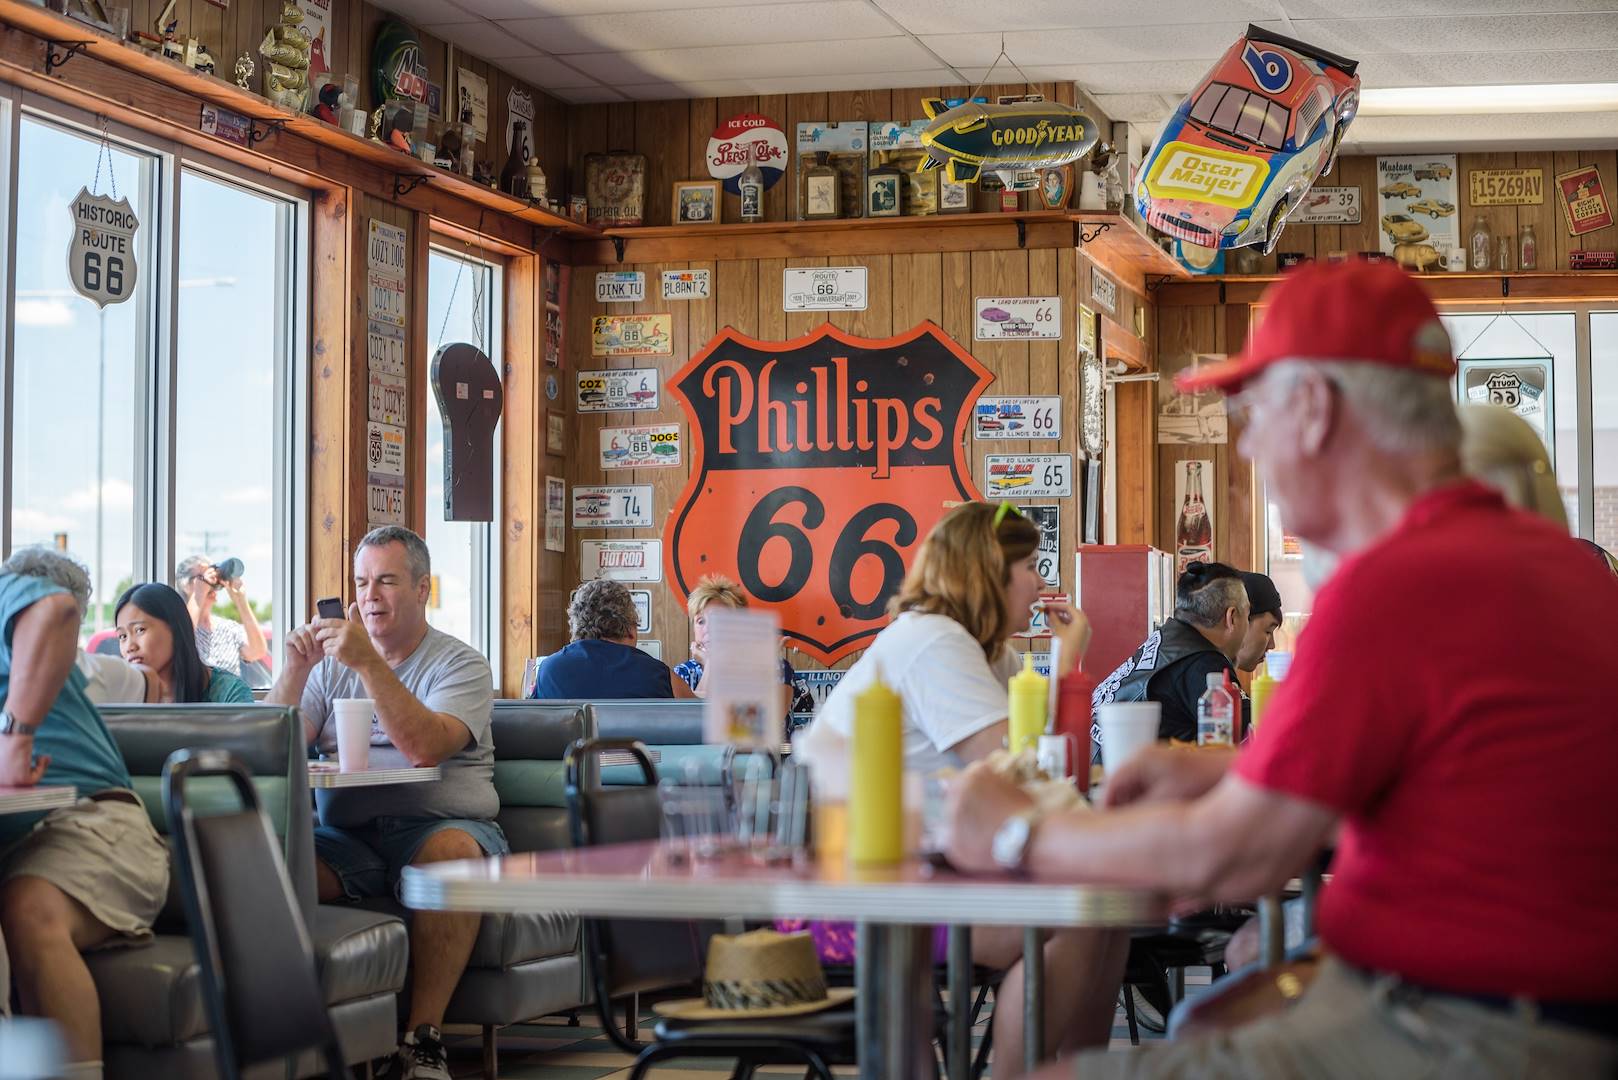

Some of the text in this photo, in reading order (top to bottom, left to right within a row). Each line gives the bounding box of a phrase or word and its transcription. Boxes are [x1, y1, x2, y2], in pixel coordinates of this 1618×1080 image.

[743, 119, 766, 127] COLD
[1182, 156, 1243, 178] Oscar
[1380, 160, 1413, 172] Mustang
[1169, 167, 1242, 193] Mayer
[1339, 194, 1354, 206] 39
[1577, 198, 1595, 208] EIGHT
[79, 202, 134, 229] HISTORIC
[624, 206, 638, 217] OIL
[1575, 204, 1600, 214] O'CLOCK
[1577, 209, 1602, 219] COFFEE
[82, 229, 126, 254] ROUTE
[372, 237, 389, 264] COZY
[84, 252, 123, 296] 66
[630, 283, 641, 294] TU
[700, 281, 706, 293] 2
[818, 284, 833, 295] 66
[1036, 307, 1052, 321] 66
[624, 331, 639, 341] 66
[653, 323, 660, 336] 6
[579, 379, 604, 389] COZ
[640, 377, 647, 391] 6
[610, 387, 623, 397] 66
[702, 357, 944, 479] Phillips
[1034, 408, 1053, 429] 66
[611, 436, 618, 450] 6
[650, 432, 678, 442] DOGS
[371, 441, 380, 460] 66
[634, 442, 647, 452] 66
[1044, 465, 1062, 486] 65
[372, 487, 390, 512] COZY
[622, 496, 640, 517] 74
[600, 552, 642, 567] HOT ROD
[737, 485, 918, 620] 66
